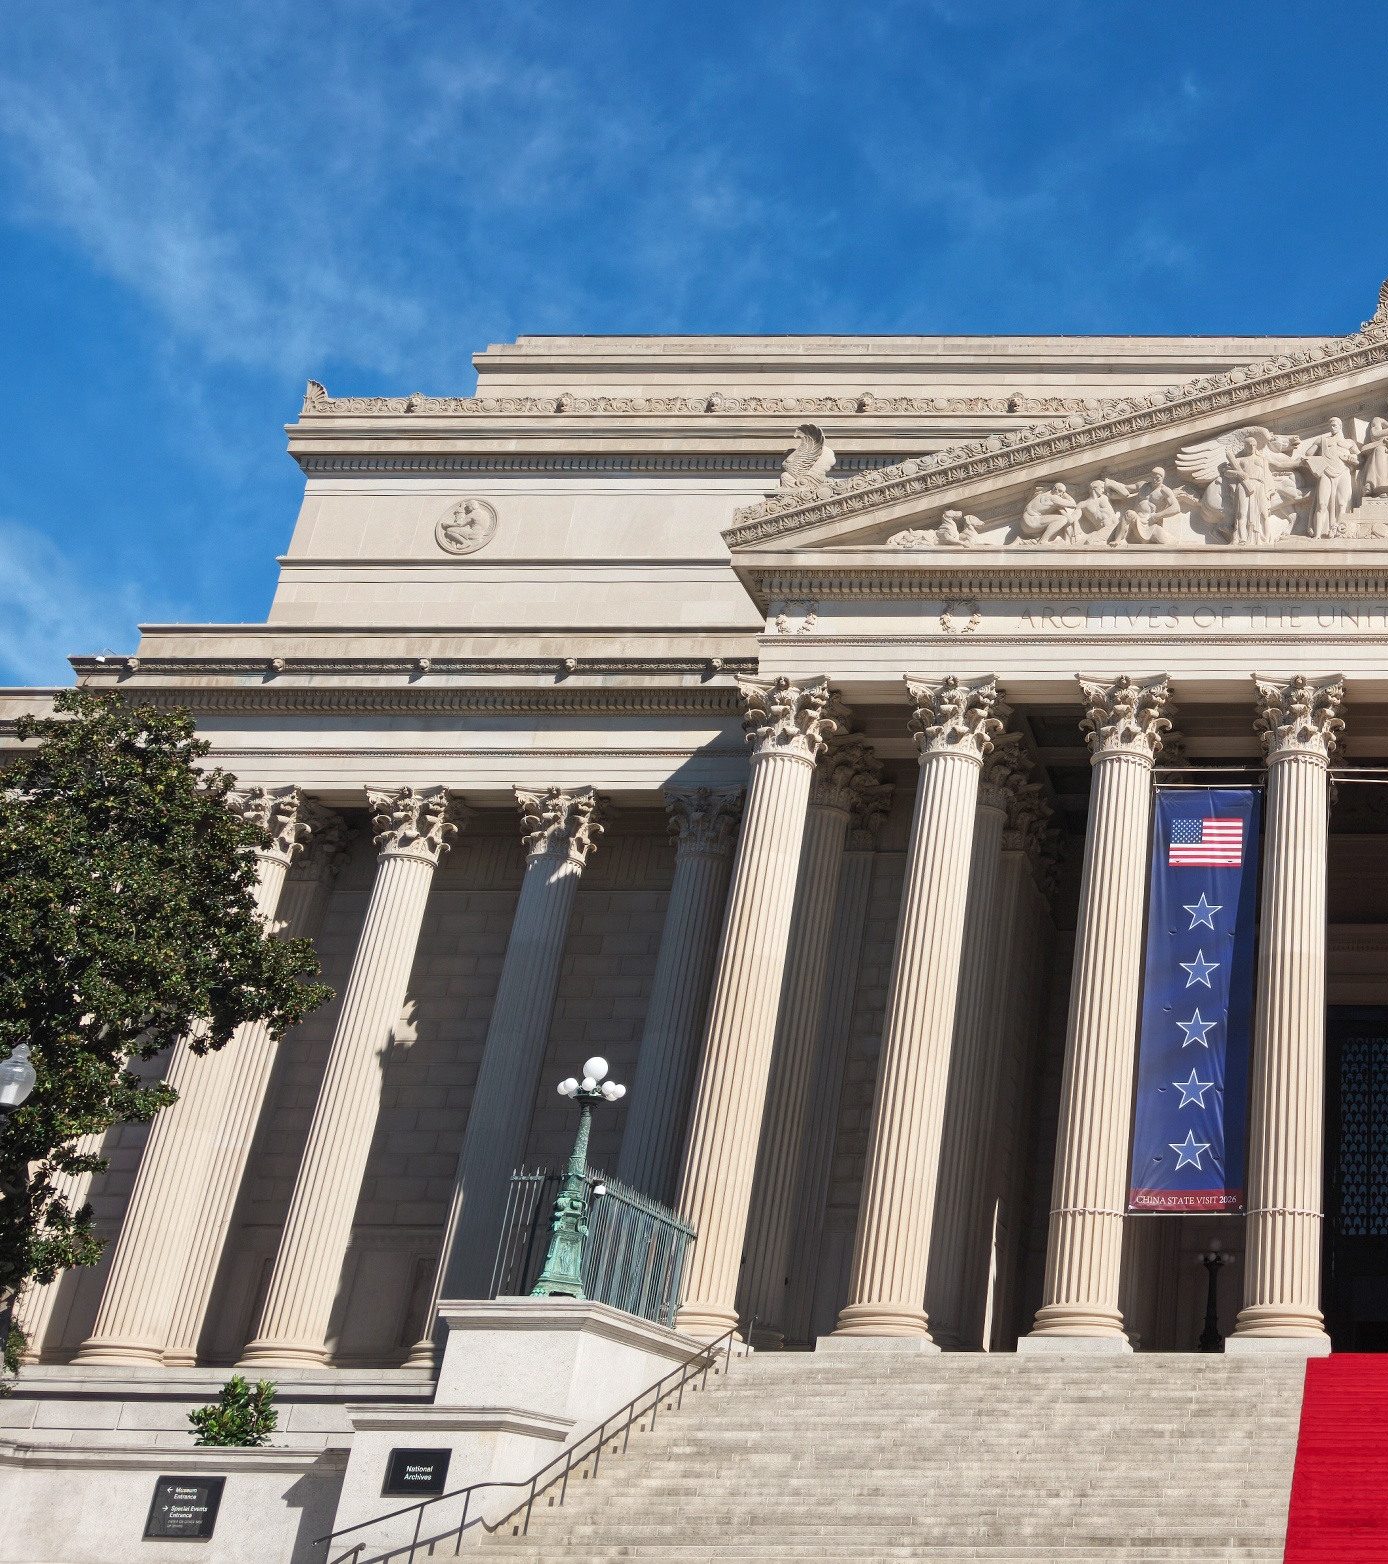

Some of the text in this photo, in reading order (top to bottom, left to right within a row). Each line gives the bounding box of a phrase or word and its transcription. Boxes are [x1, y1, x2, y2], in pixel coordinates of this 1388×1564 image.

[1015, 606, 1180, 629] ARCHIVES
[1192, 606, 1233, 629] OF
[1245, 606, 1303, 629] THE
[1136, 1195, 1237, 1205] CHINA STATE VISIT 2026
[406, 1465, 434, 1473] National
[403, 1473, 432, 1481] Archives
